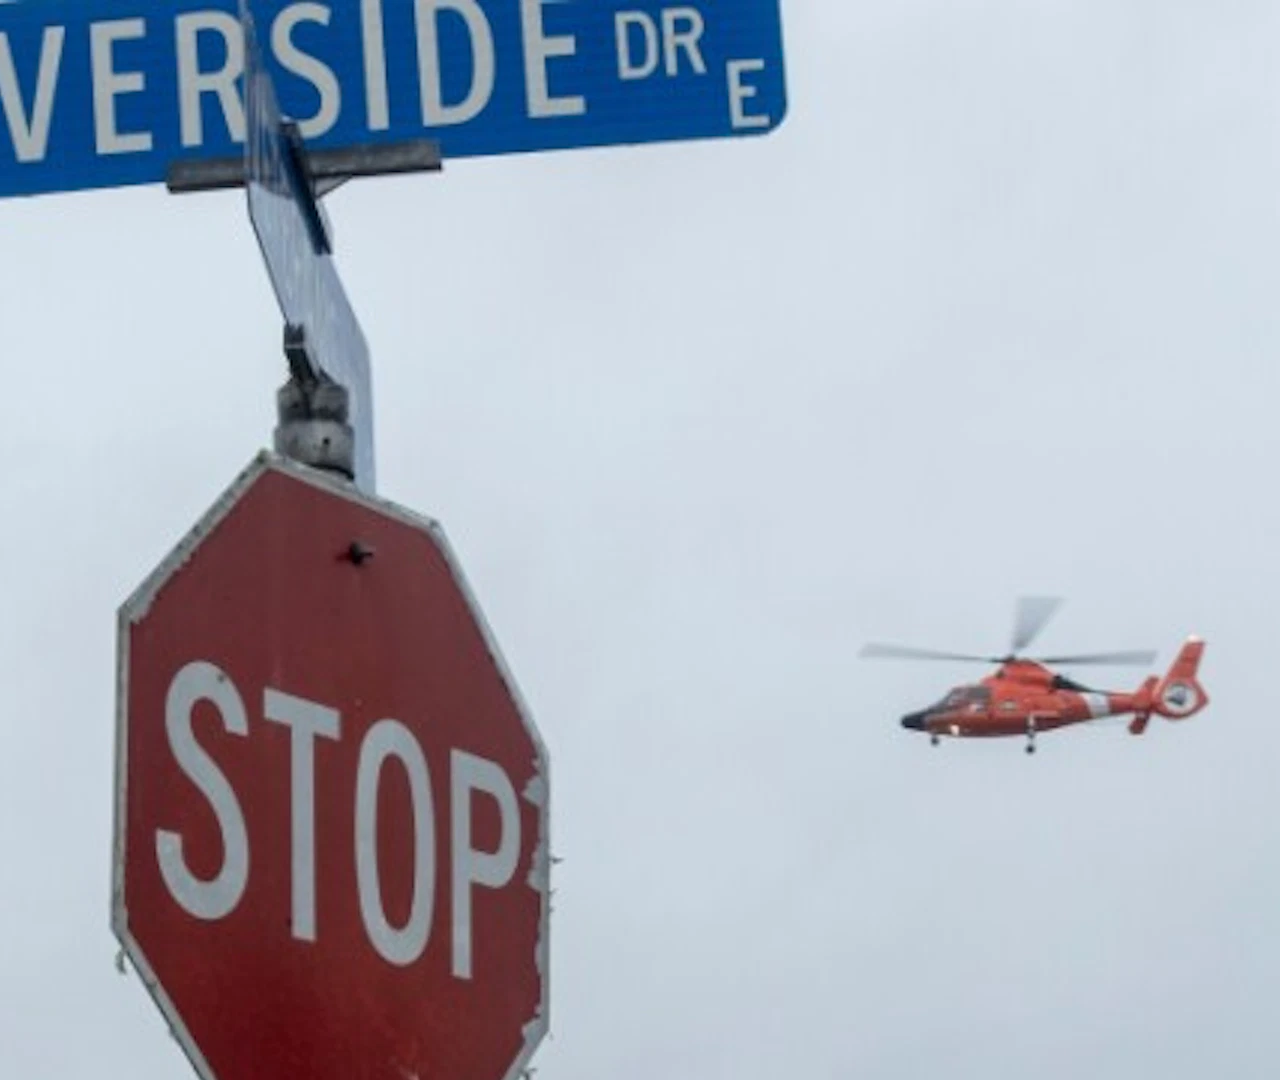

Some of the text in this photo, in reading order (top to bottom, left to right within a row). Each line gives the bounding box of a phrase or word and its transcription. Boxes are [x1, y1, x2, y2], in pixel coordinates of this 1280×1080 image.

[614, 8, 706, 80] DR
[726, 59, 771, 129] E
[155, 660, 522, 980] STOP
